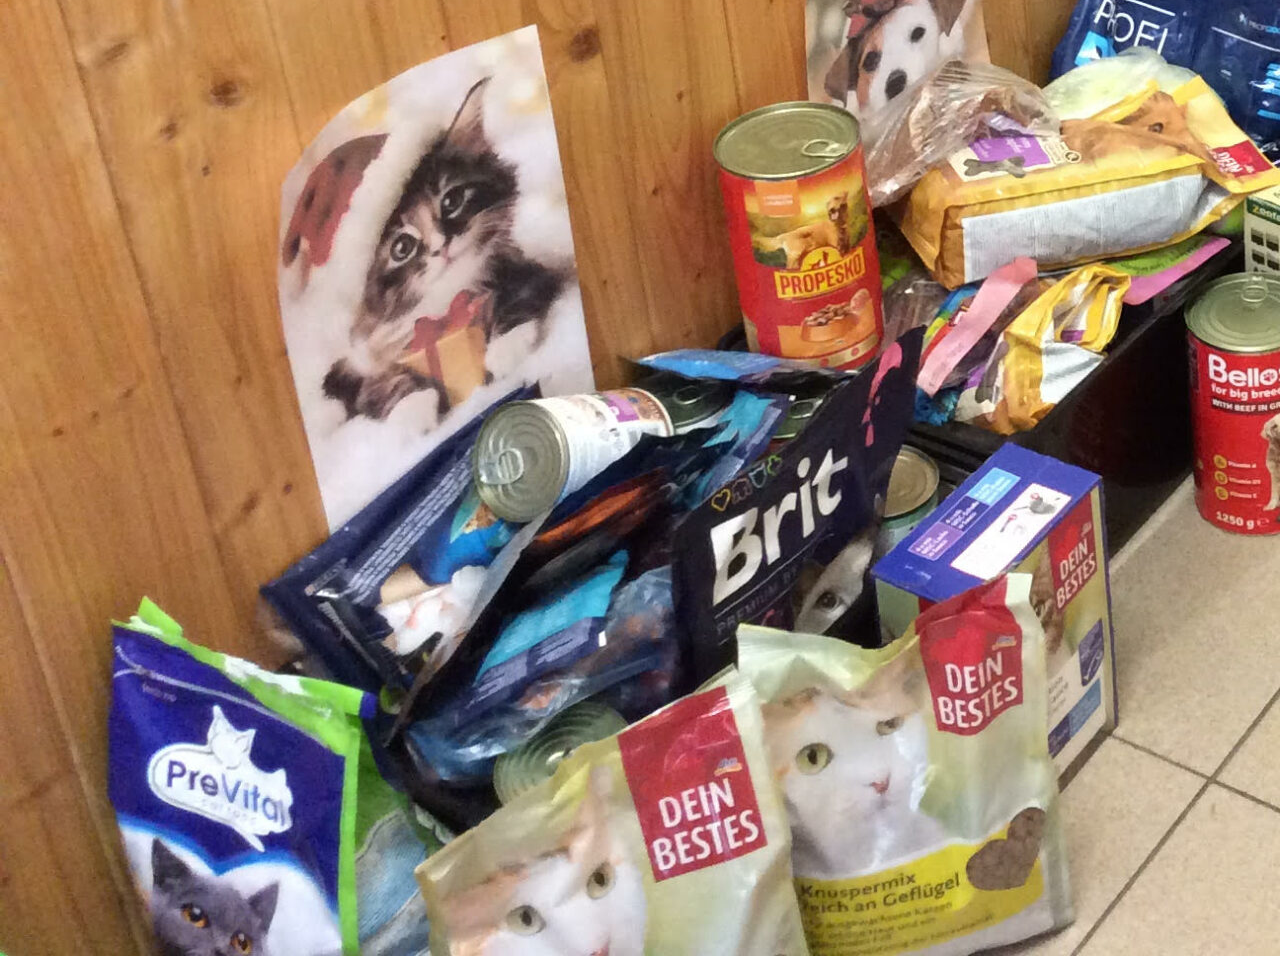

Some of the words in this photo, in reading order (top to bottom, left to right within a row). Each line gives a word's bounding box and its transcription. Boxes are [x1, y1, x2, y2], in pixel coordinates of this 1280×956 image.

[780, 253, 862, 296] PROPESKO
[1211, 382, 1227, 396] for
[1229, 388, 1249, 401] big
[1212, 397, 1233, 411] WITH
[1234, 403, 1257, 413] BEEF
[1258, 403, 1268, 412] IN
[711, 448, 849, 607] Brit
[1216, 510, 1244, 526] 1250
[1246, 520, 1255, 530] g
[1056, 552, 1096, 609] BESTES
[1060, 538, 1088, 580] DEIN
[944, 651, 1003, 694] DEIN
[937, 676, 1018, 729] BESTES
[166, 759, 287, 827] PreVital
[658, 777, 735, 828] DEIN
[652, 809, 759, 871] BESTES
[800, 873, 916, 901] Knuspermix
[854, 900, 877, 912] an
[883, 871, 960, 906] Geflügel
